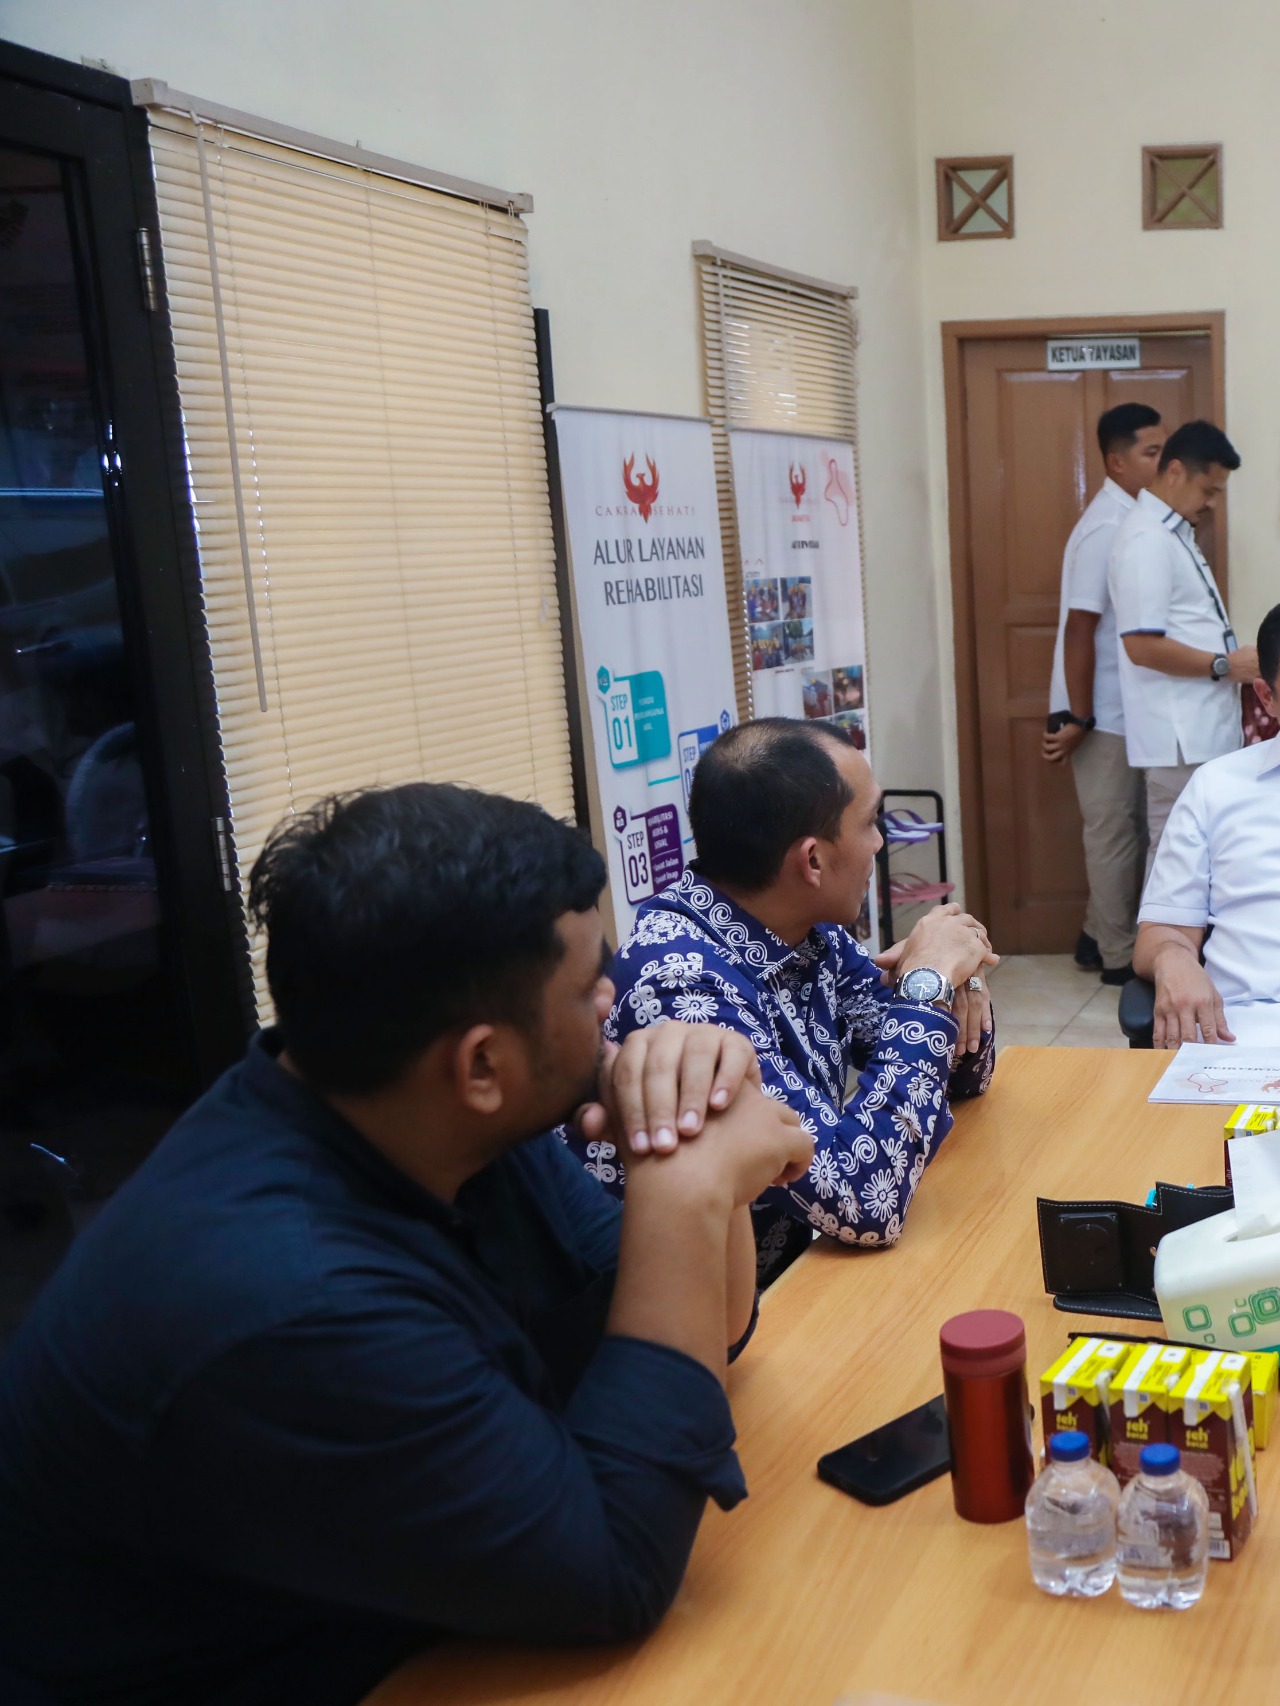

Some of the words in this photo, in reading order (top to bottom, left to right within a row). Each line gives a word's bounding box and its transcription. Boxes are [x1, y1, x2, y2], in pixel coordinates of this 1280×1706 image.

[1051, 346, 1086, 362] KETUA
[595, 503, 638, 518] CAKRA
[652, 504, 696, 517] SEHATI
[593, 538, 635, 566] ALUR
[638, 535, 706, 563] LAYANAN
[603, 573, 704, 607] REHABILITASI
[610, 693, 628, 711] STEP
[612, 714, 632, 751] 01
[683, 746, 696, 763] STEP
[626, 831, 645, 850] STEP
[628, 851, 649, 888] 03
